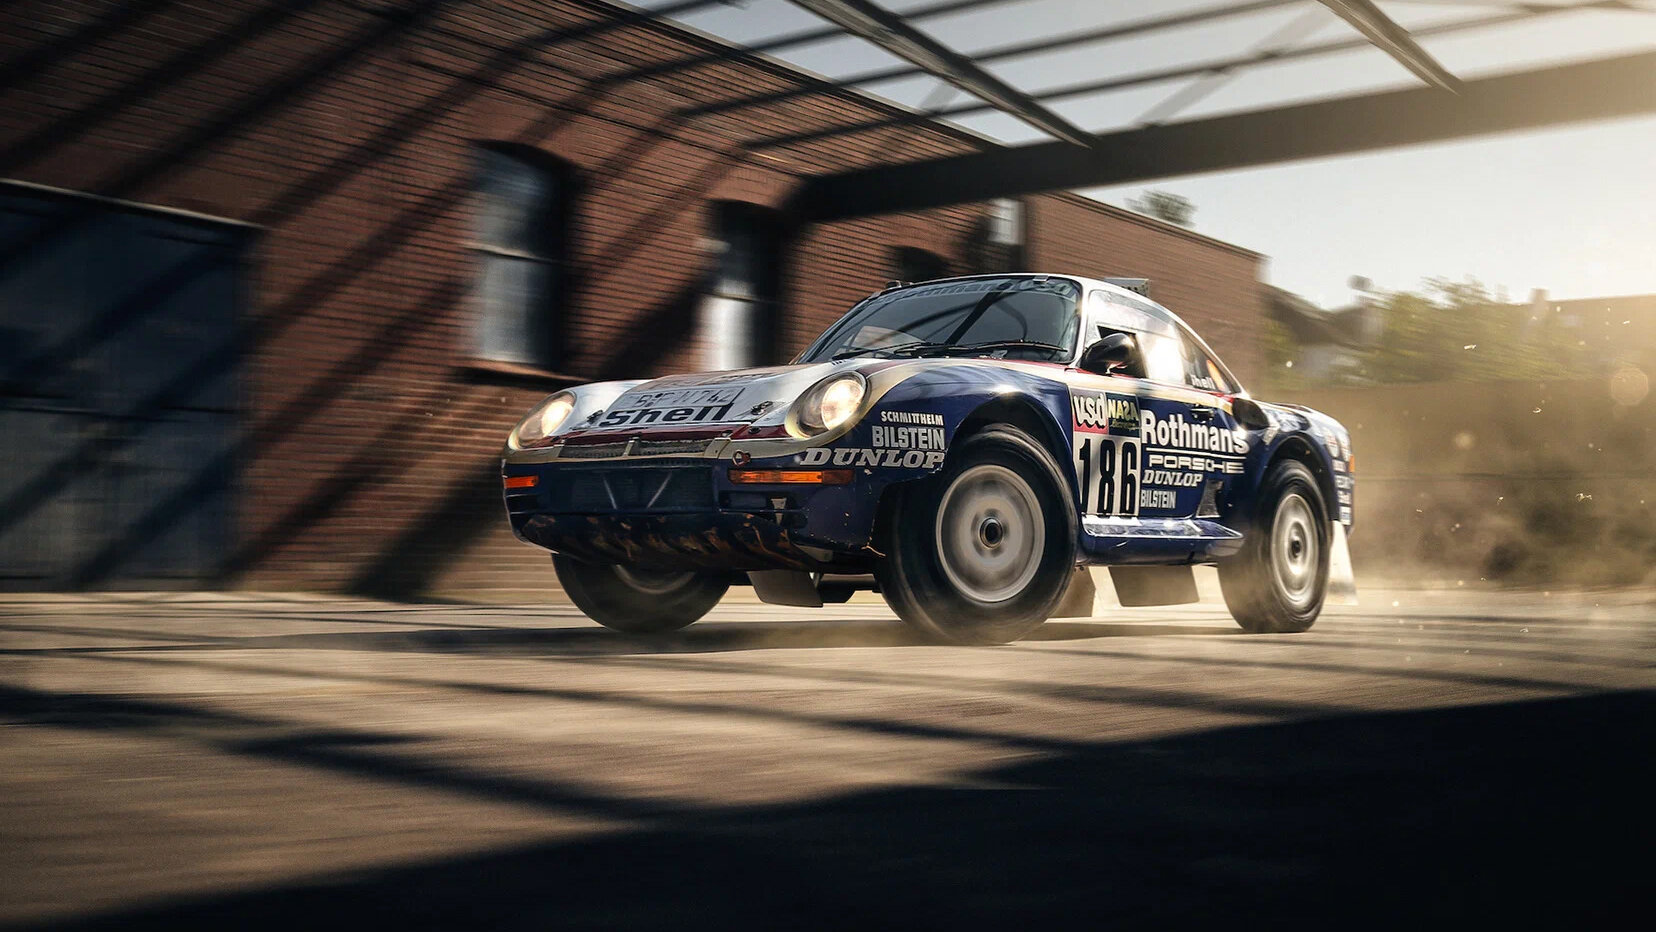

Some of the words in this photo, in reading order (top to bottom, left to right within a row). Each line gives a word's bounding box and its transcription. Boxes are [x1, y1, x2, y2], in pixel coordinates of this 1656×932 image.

[600, 403, 734, 425] Shell
[872, 425, 945, 450] BILSTEIN
[1141, 410, 1250, 455] Rothmans
[800, 447, 945, 469] DUNLOP
[1149, 455, 1246, 474] PORSCHE
[1079, 438, 1137, 515] 186
[1142, 469, 1204, 487] DUNLOP
[1140, 489, 1177, 509] BILSTEIN
